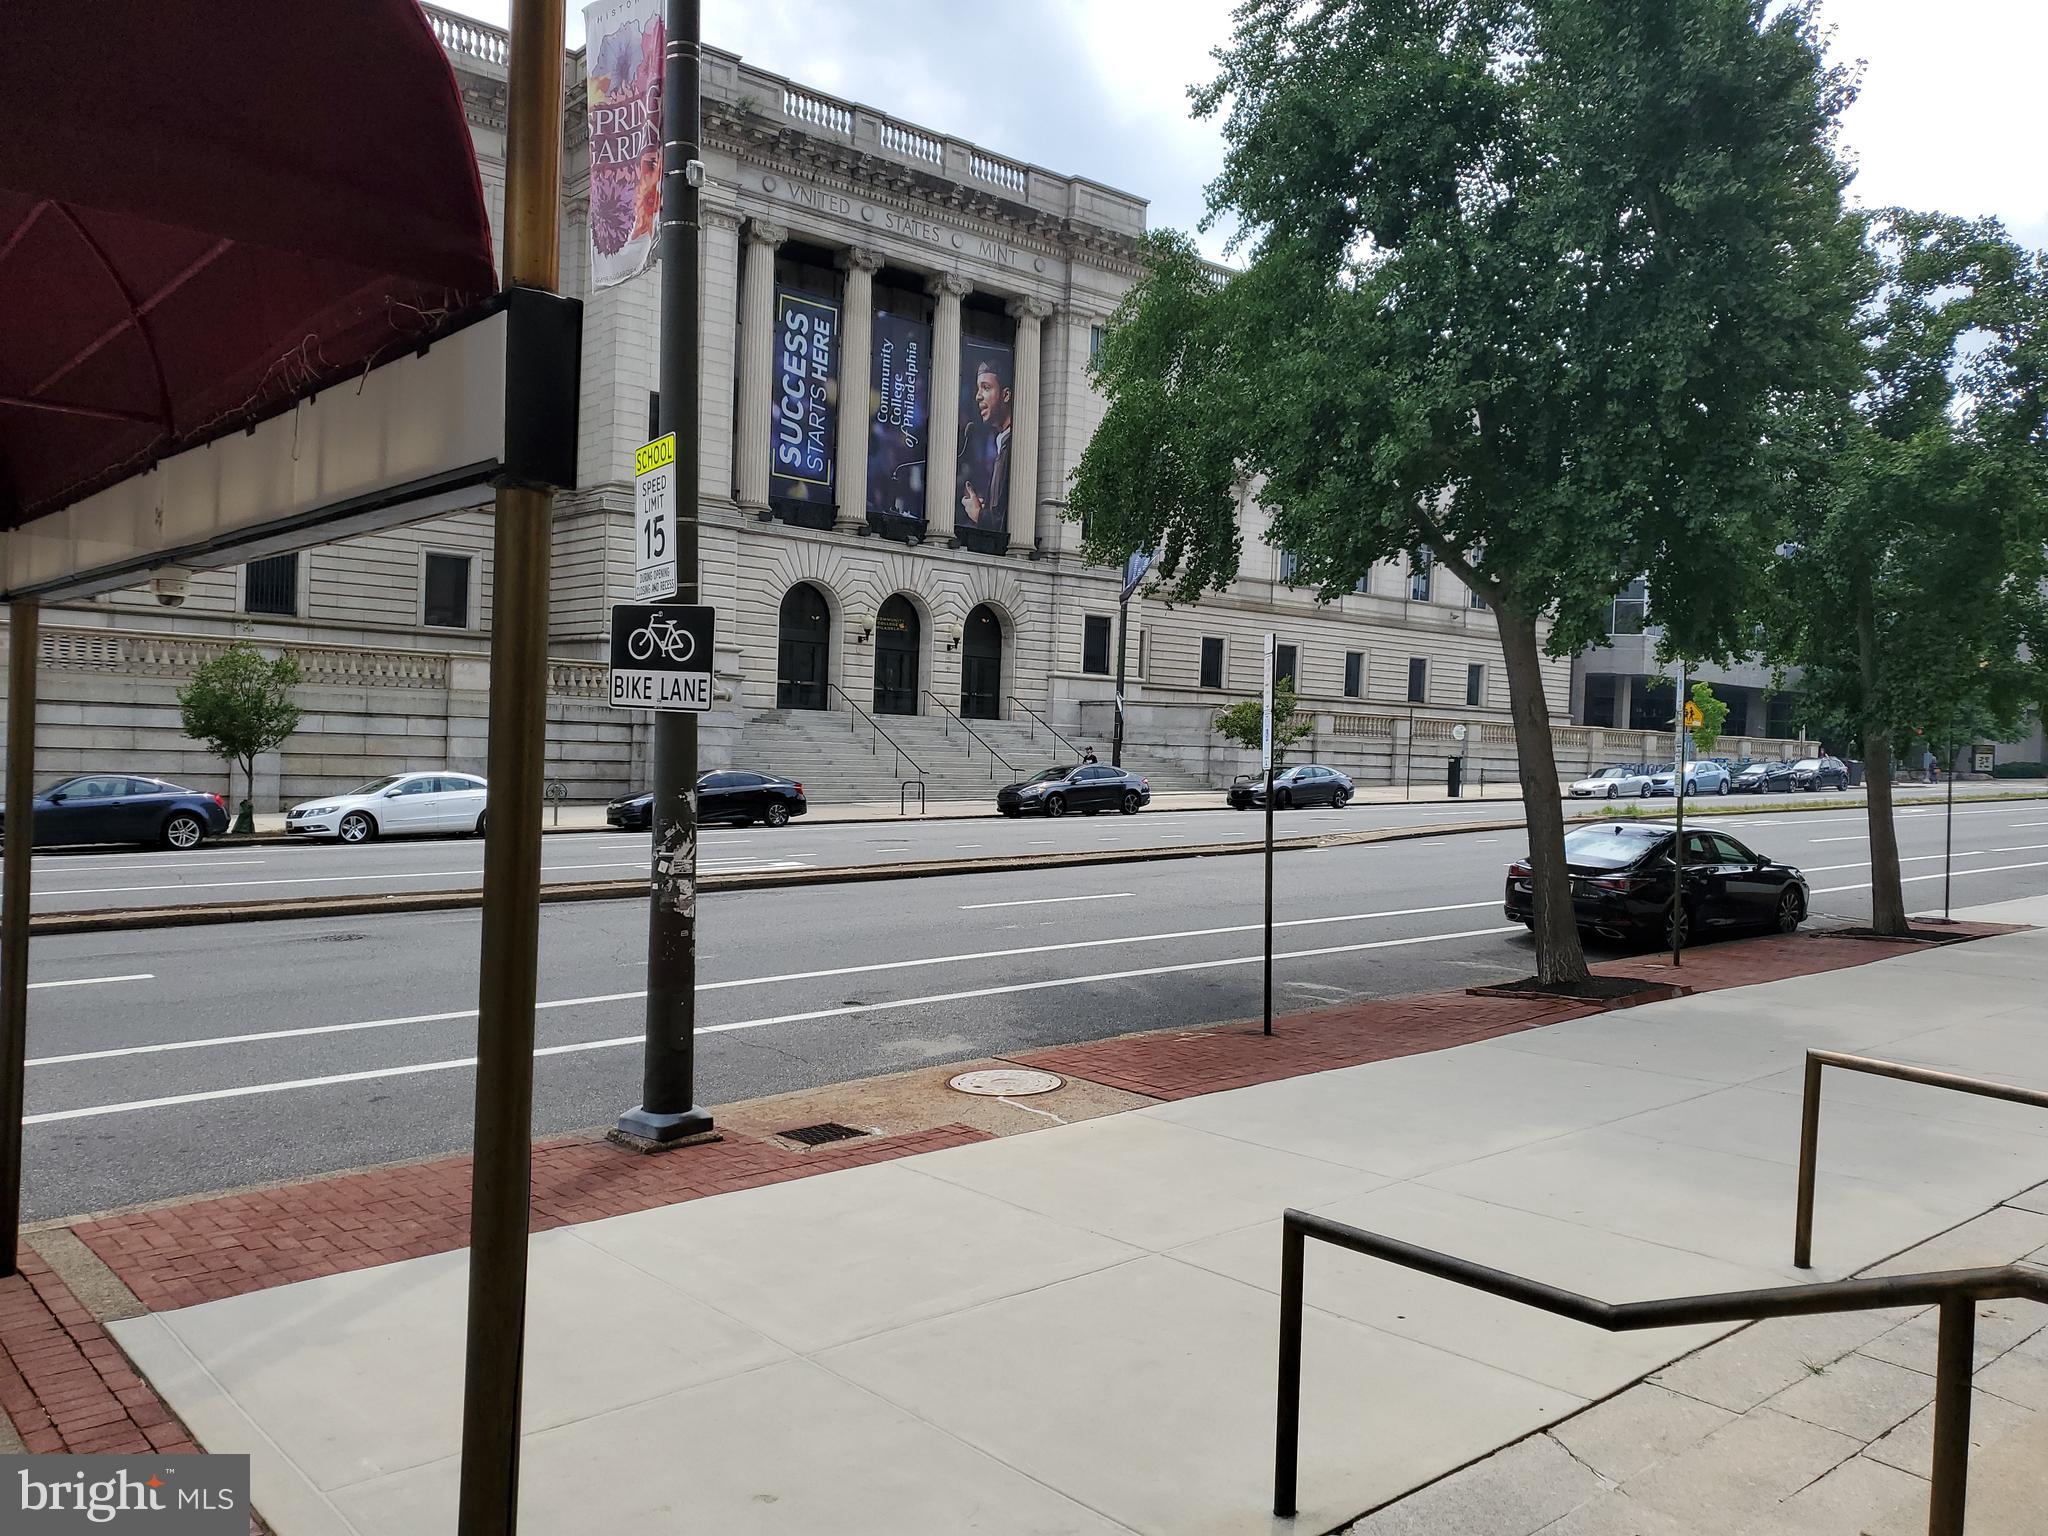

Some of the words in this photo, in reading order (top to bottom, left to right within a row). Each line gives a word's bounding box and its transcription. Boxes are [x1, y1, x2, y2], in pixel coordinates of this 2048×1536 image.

[885, 212, 940, 243] STATES
[978, 240, 1018, 265] MINT
[812, 317, 830, 382] HERE
[780, 309, 809, 468] SUCCESS
[877, 338, 894, 423] Community
[890, 373, 906, 426] College
[903, 342, 918, 428] Philadelphia
[806, 384, 827, 472] STARTS
[900, 425, 918, 448] of
[636, 440, 673, 472] SCHOOL
[642, 475, 667, 497] SPEED
[644, 494, 664, 514] LIMIT
[644, 514, 665, 560] 15
[614, 675, 653, 700] BIKE
[660, 677, 708, 703] LANE
